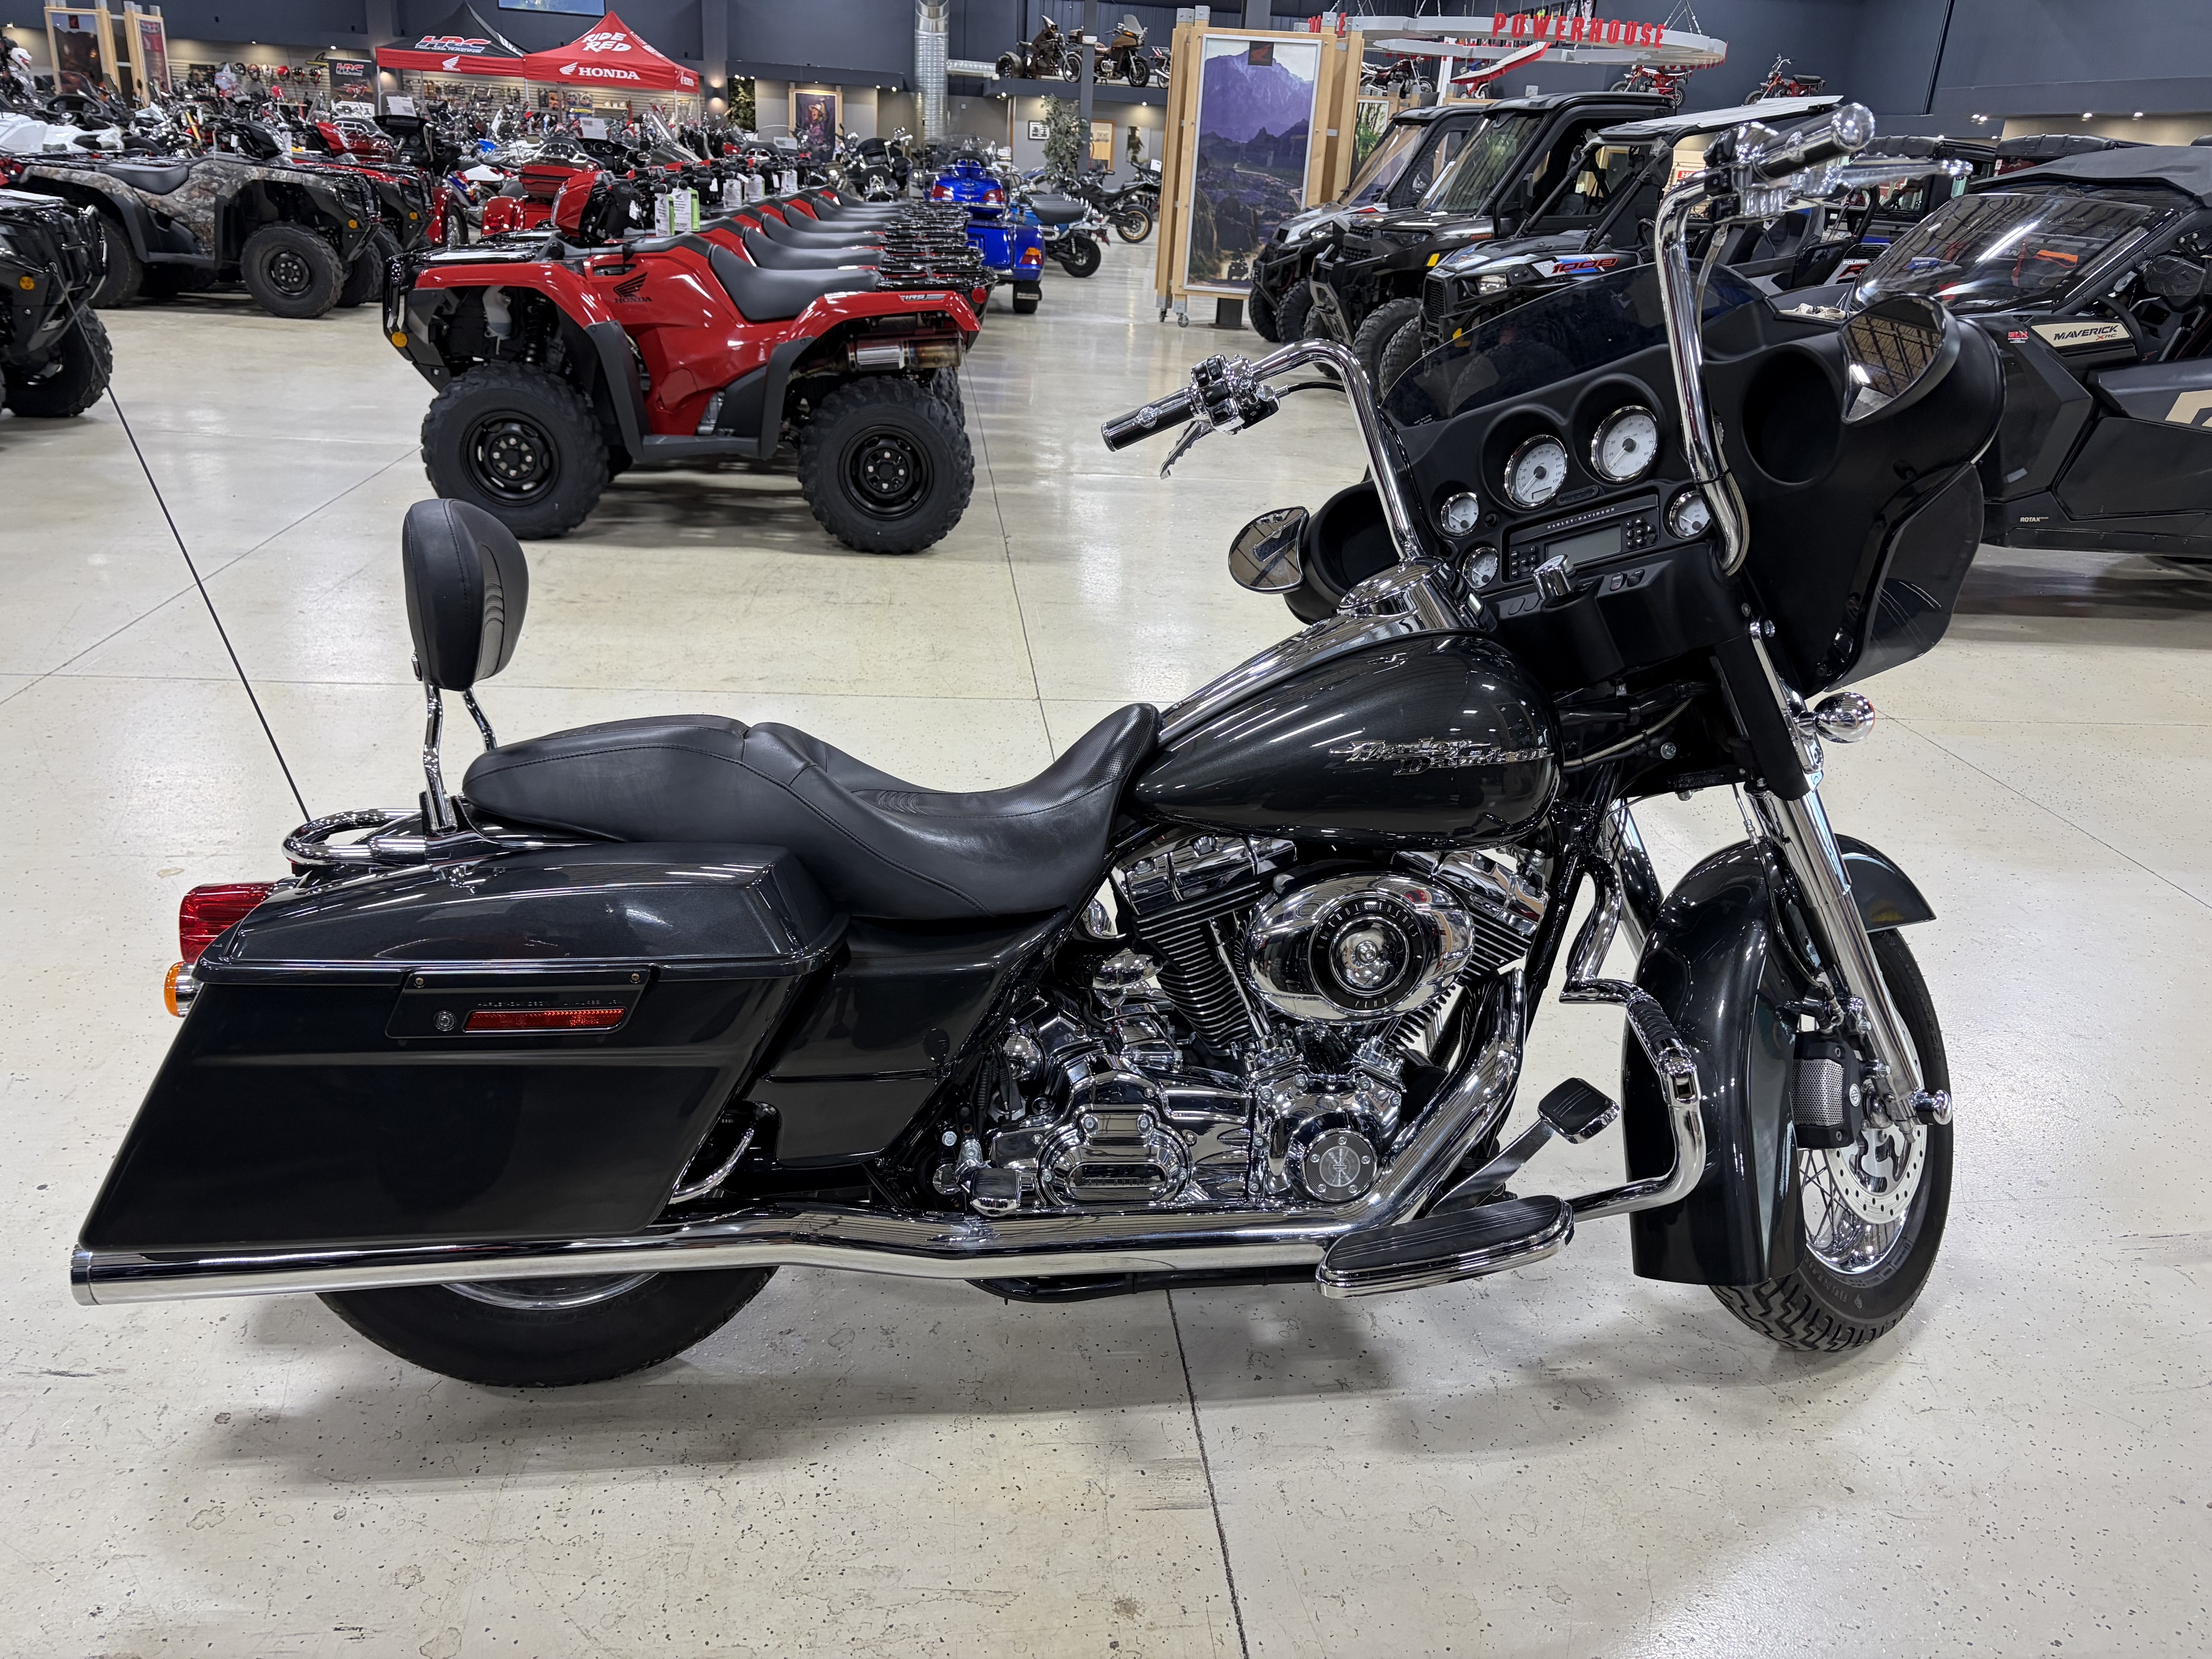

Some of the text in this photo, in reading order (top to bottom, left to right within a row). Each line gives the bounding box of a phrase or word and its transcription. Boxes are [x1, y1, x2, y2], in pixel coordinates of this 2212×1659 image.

[1491, 12, 1666, 48] POWERHOUSE
[415, 36, 491, 50] HRC
[581, 32, 627, 43] RIDE
[582, 41, 632, 53] RED
[578, 67, 641, 80] HONDA
[1551, 257, 1618, 274] 1000
[2053, 325, 2119, 341] MAVERICK
